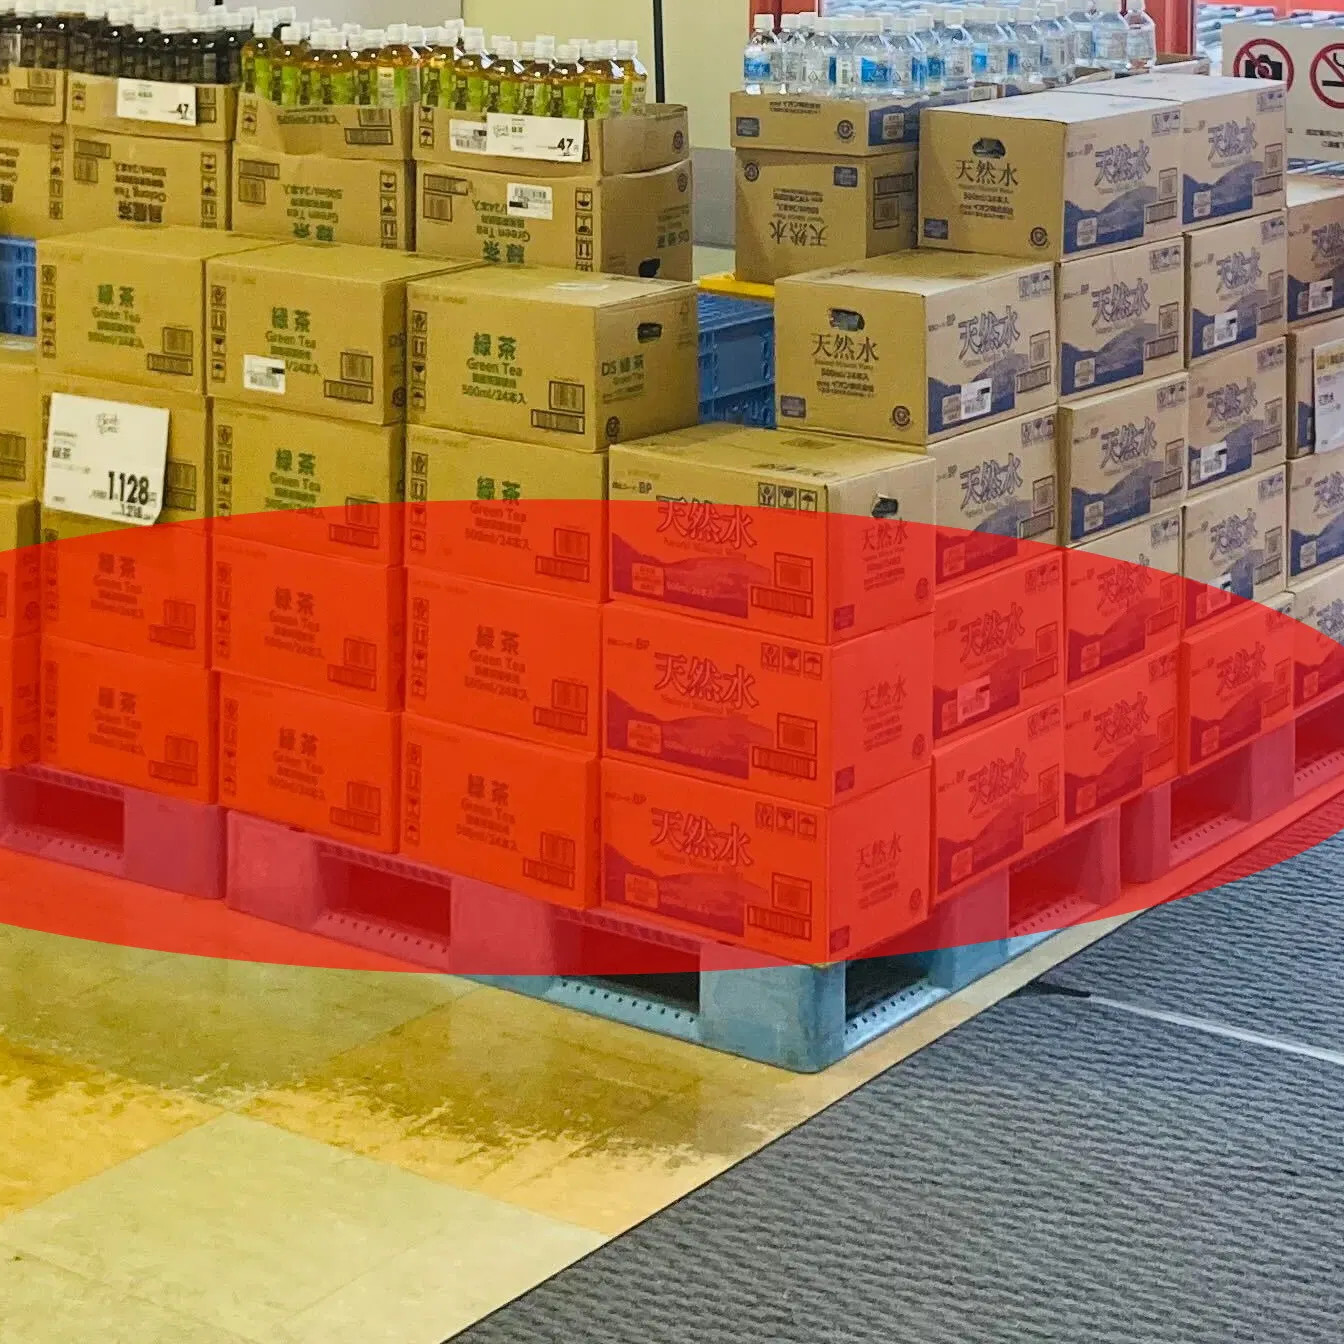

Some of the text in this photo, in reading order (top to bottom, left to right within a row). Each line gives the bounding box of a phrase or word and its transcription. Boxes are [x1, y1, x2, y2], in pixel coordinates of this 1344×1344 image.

[175, 103, 189, 115] 47
[557, 137, 575, 151] 47
[955, 159, 1019, 187] 天然水
[1094, 139, 1151, 188] 天然水
[769, 220, 829, 247] 天然水
[1091, 277, 1151, 327] 天然水
[265, 330, 317, 350] Green Tea
[473, 332, 517, 361] 緑茶
[811, 333, 880, 362] 天然水
[958, 305, 1021, 361] 天然水
[466, 357, 523, 378] Green Tea
[1100, 415, 1158, 469] 天然水
[477, 476, 521, 506] 緑茶
[959, 452, 1024, 512] 天然水
[655, 495, 757, 550] 天然水
[859, 517, 908, 552] 天然水
[653, 651, 759, 710] 天然水
[650, 806, 754, 867] 天然水
